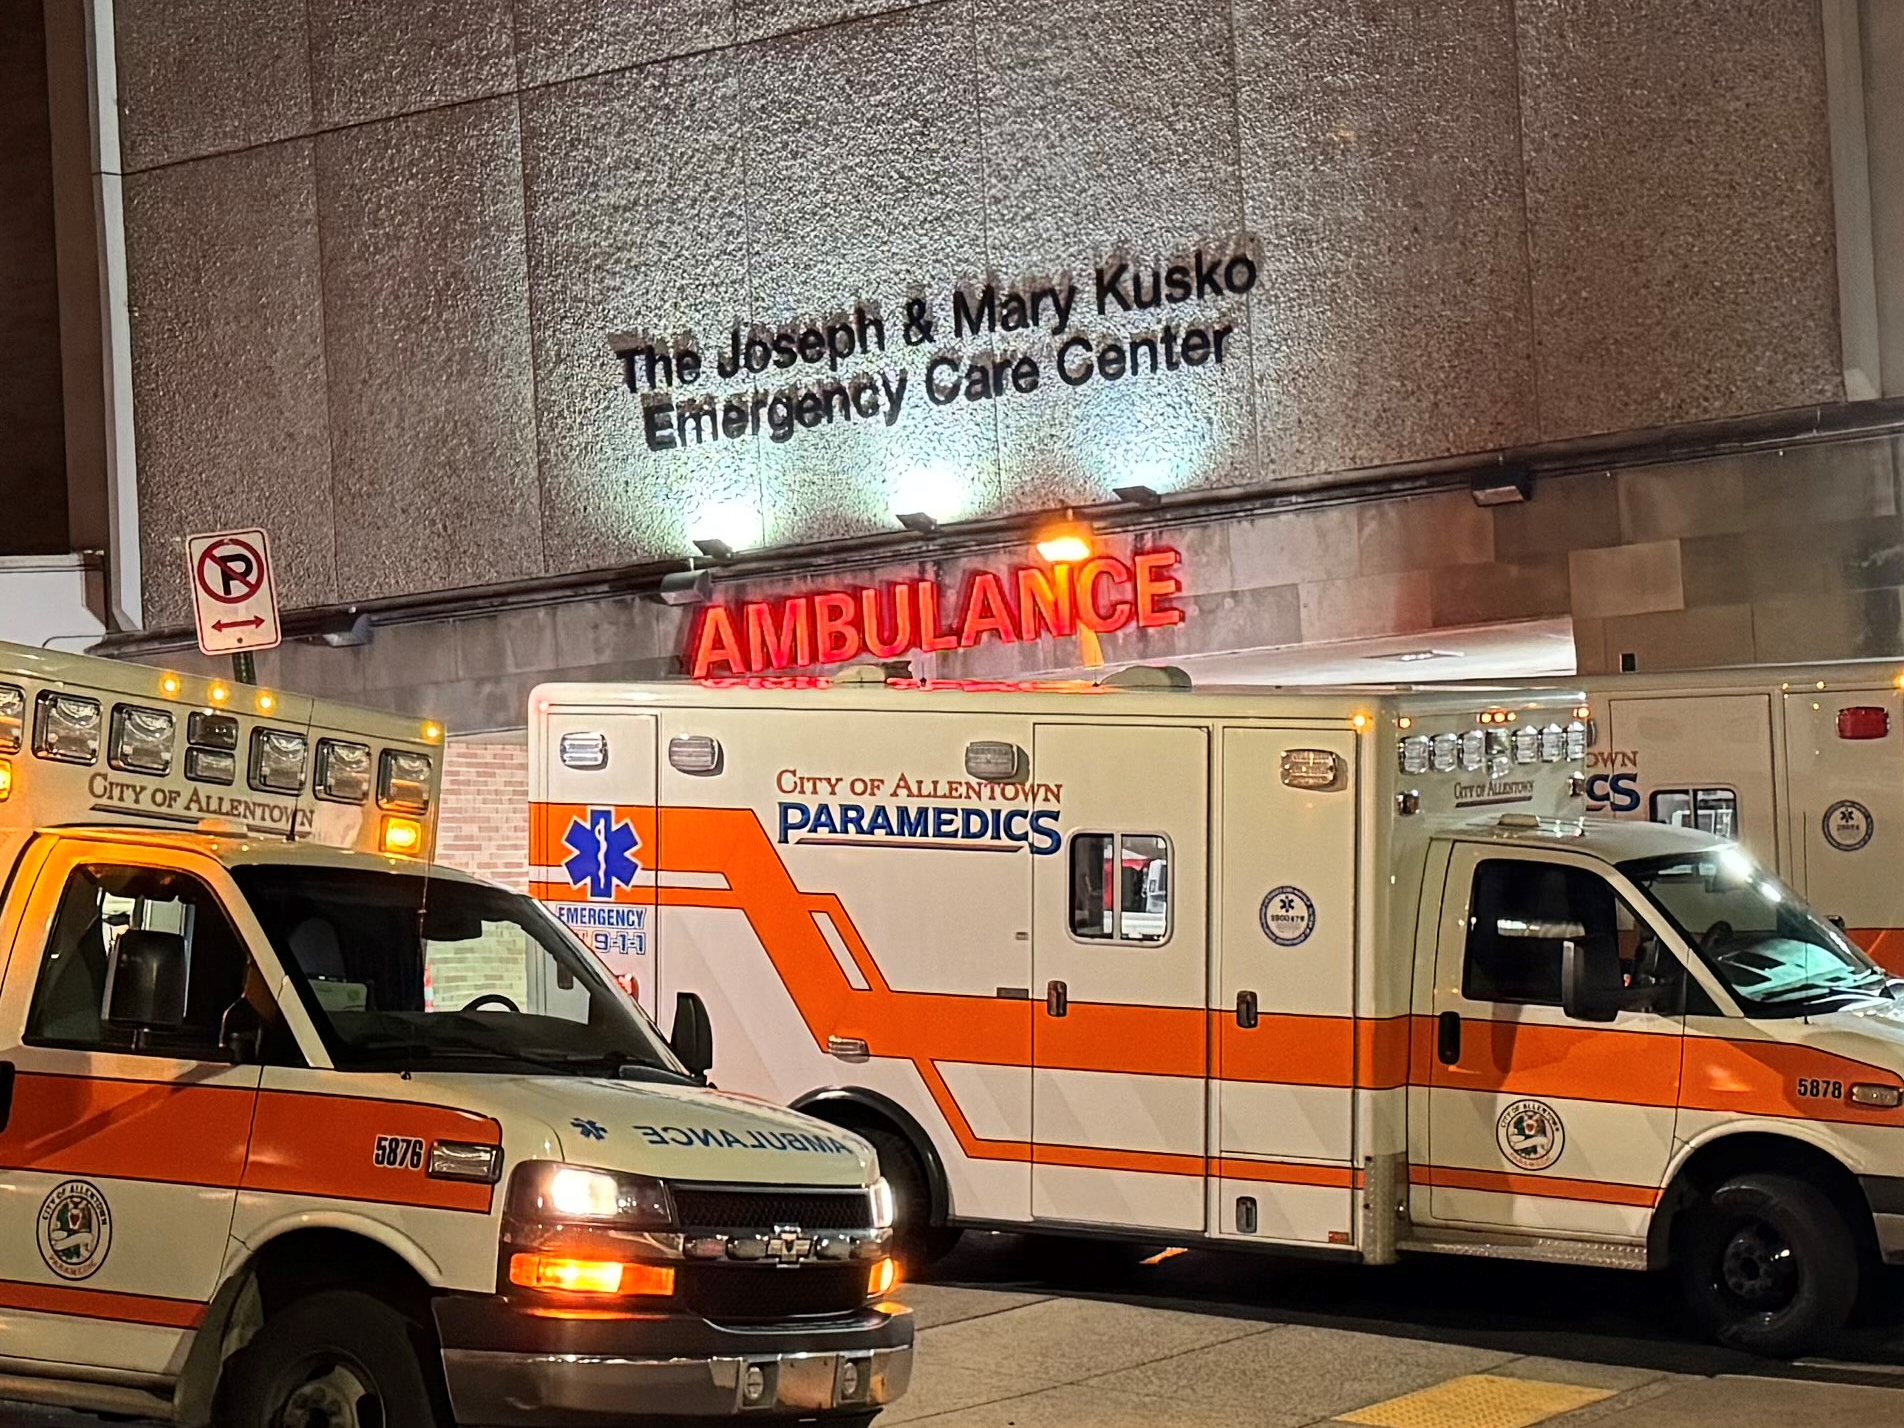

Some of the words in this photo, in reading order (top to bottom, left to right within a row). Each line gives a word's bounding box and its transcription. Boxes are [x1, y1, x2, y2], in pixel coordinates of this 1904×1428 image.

[617, 346, 698, 393] The
[717, 310, 884, 379] Joseph
[903, 297, 934, 346] &
[952, 283, 1077, 336] Mary
[1096, 253, 1258, 315] Kusko
[643, 369, 907, 452] Emergency
[925, 353, 1039, 407] Care
[1057, 321, 1233, 387] Center
[693, 548, 1183, 679] AMBULANCE
[88, 772, 147, 805] CITY
[151, 787, 181, 808] OF
[184, 786, 315, 829] ALLENTOWN
[776, 769, 843, 796] CITY
[850, 778, 884, 797] OF
[890, 772, 1063, 804] ALLENTOWN
[777, 801, 1062, 855] PARAMEDICS
[558, 906, 644, 928] EMERGENCY
[595, 933, 644, 952] 9-1-1
[1797, 1078, 1842, 1099] 5878
[374, 1136, 424, 1171] 5876
